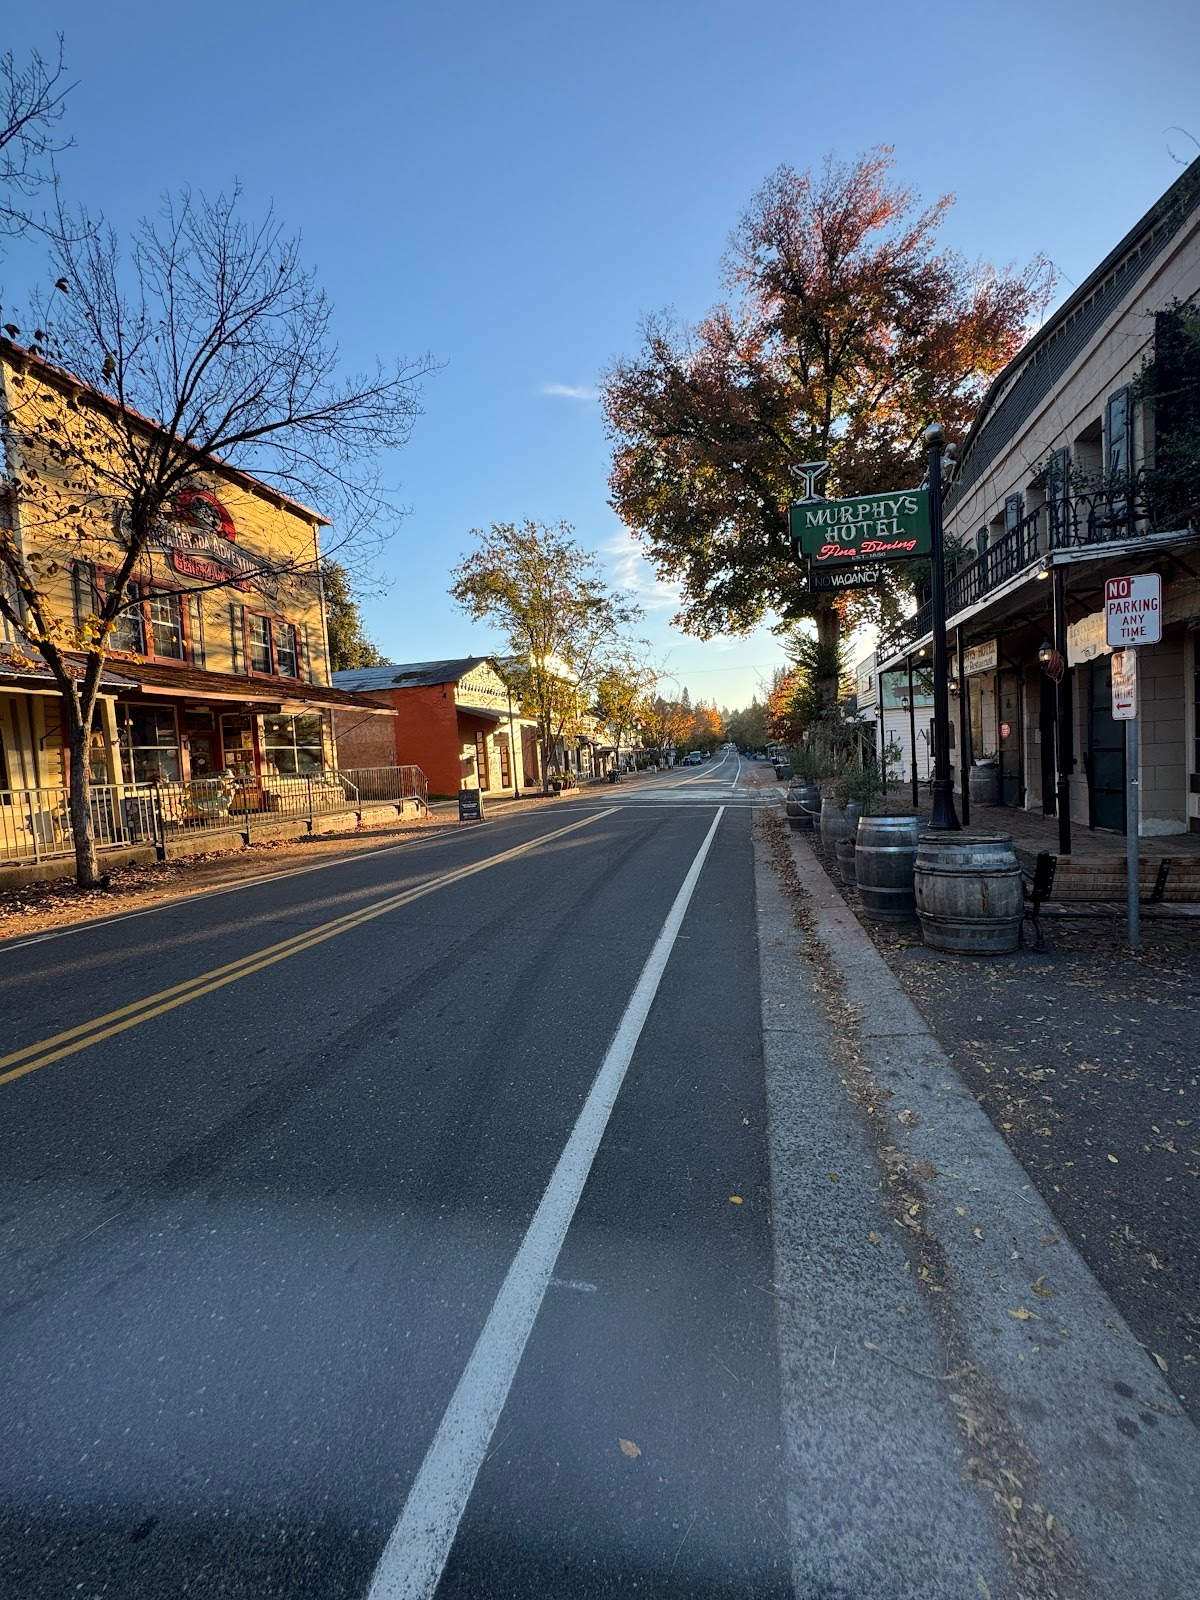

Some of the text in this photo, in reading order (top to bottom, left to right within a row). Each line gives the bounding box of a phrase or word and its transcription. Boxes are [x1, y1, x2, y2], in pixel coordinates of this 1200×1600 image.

[805, 496, 919, 528] MURPHYS
[825, 518, 906, 543] HOTEL
[816, 540, 917, 560] Fine Dining
[815, 570, 879, 587] NO VACANCY
[1109, 580, 1128, 597] NO
[1109, 598, 1158, 615] PARKING
[1122, 614, 1145, 626] ANY
[1121, 626, 1147, 638] TIME
